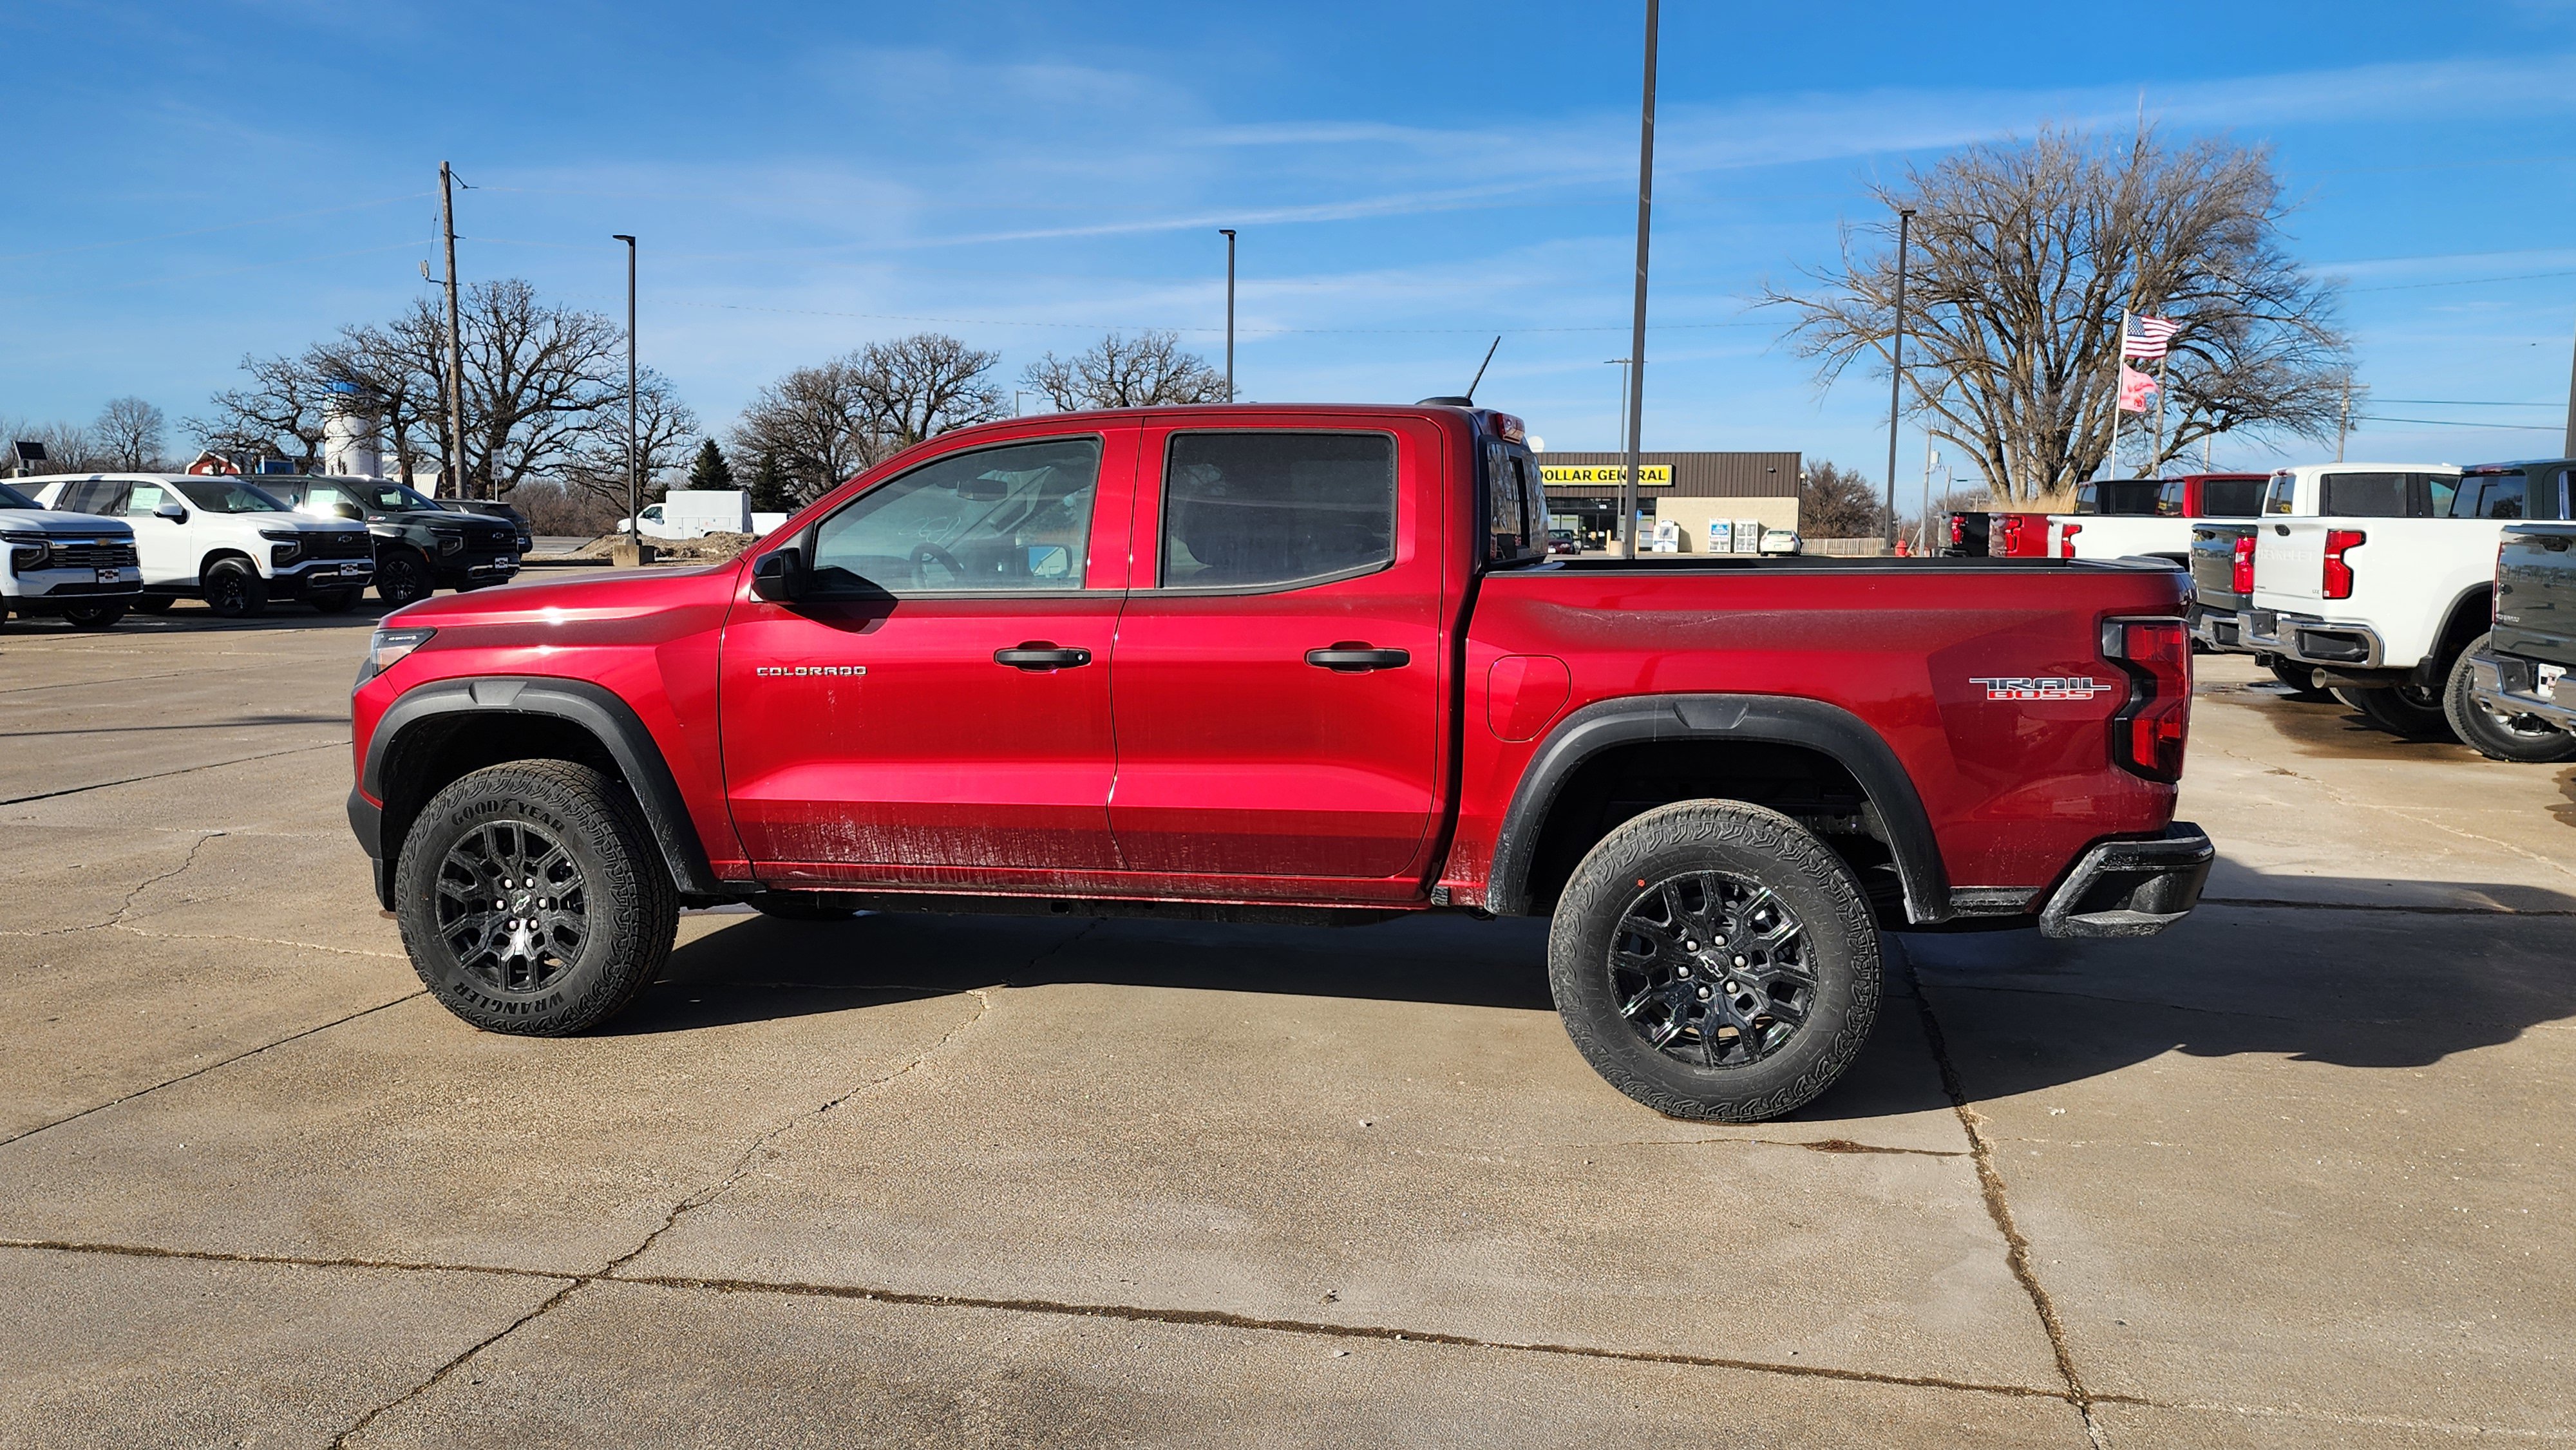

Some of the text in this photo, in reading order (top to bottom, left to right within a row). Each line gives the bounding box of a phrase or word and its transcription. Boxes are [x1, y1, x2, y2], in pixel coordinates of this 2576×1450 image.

[493, 466, 502, 476] 45
[1597, 469, 1666, 481] GENRAL
[757, 666, 867, 676] COLORADO
[1969, 677, 2111, 691] TRAIL
[1987, 690, 2094, 701] BOSS
[453, 982, 565, 1015] WRANGLER
